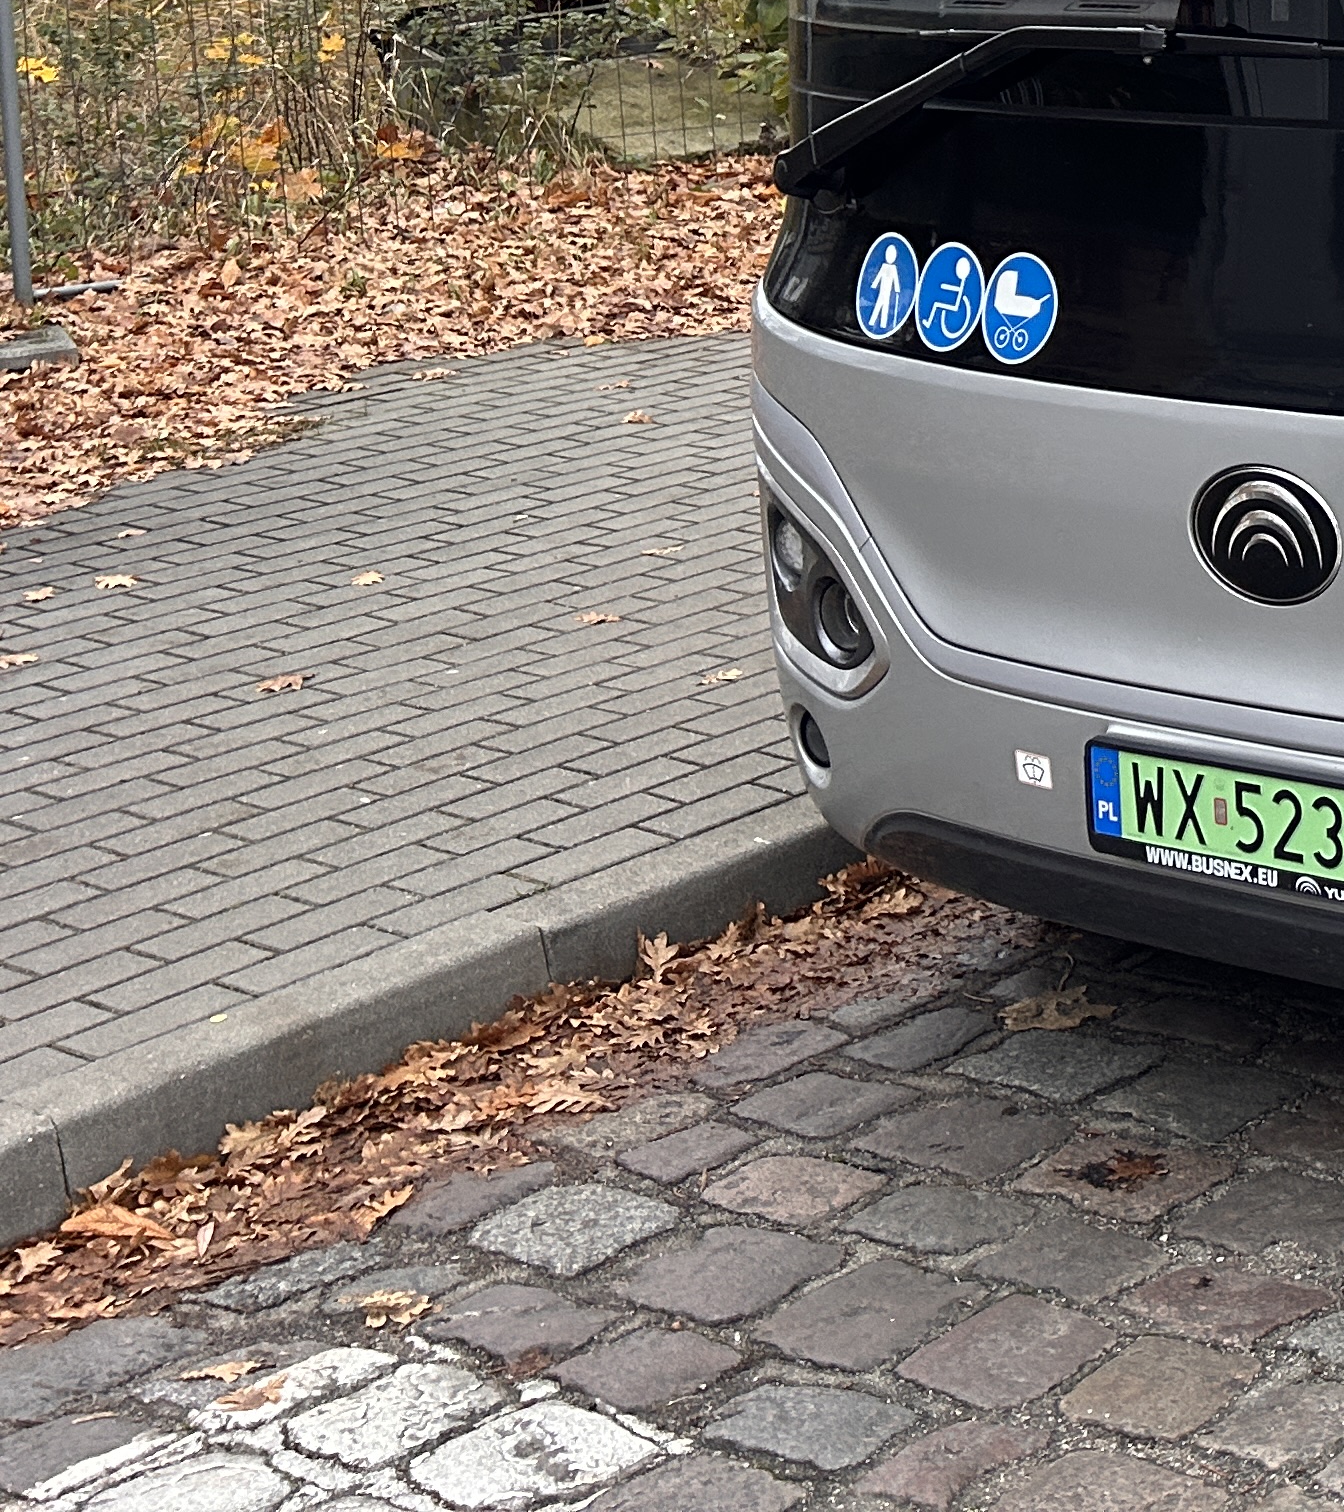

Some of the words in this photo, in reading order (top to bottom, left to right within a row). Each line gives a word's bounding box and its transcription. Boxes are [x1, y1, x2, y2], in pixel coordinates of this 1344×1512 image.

[1097, 799, 1119, 822] PL
[1131, 761, 1207, 846] WX
[1145, 845, 1278, 888] WWW.BUSNEX.EU
